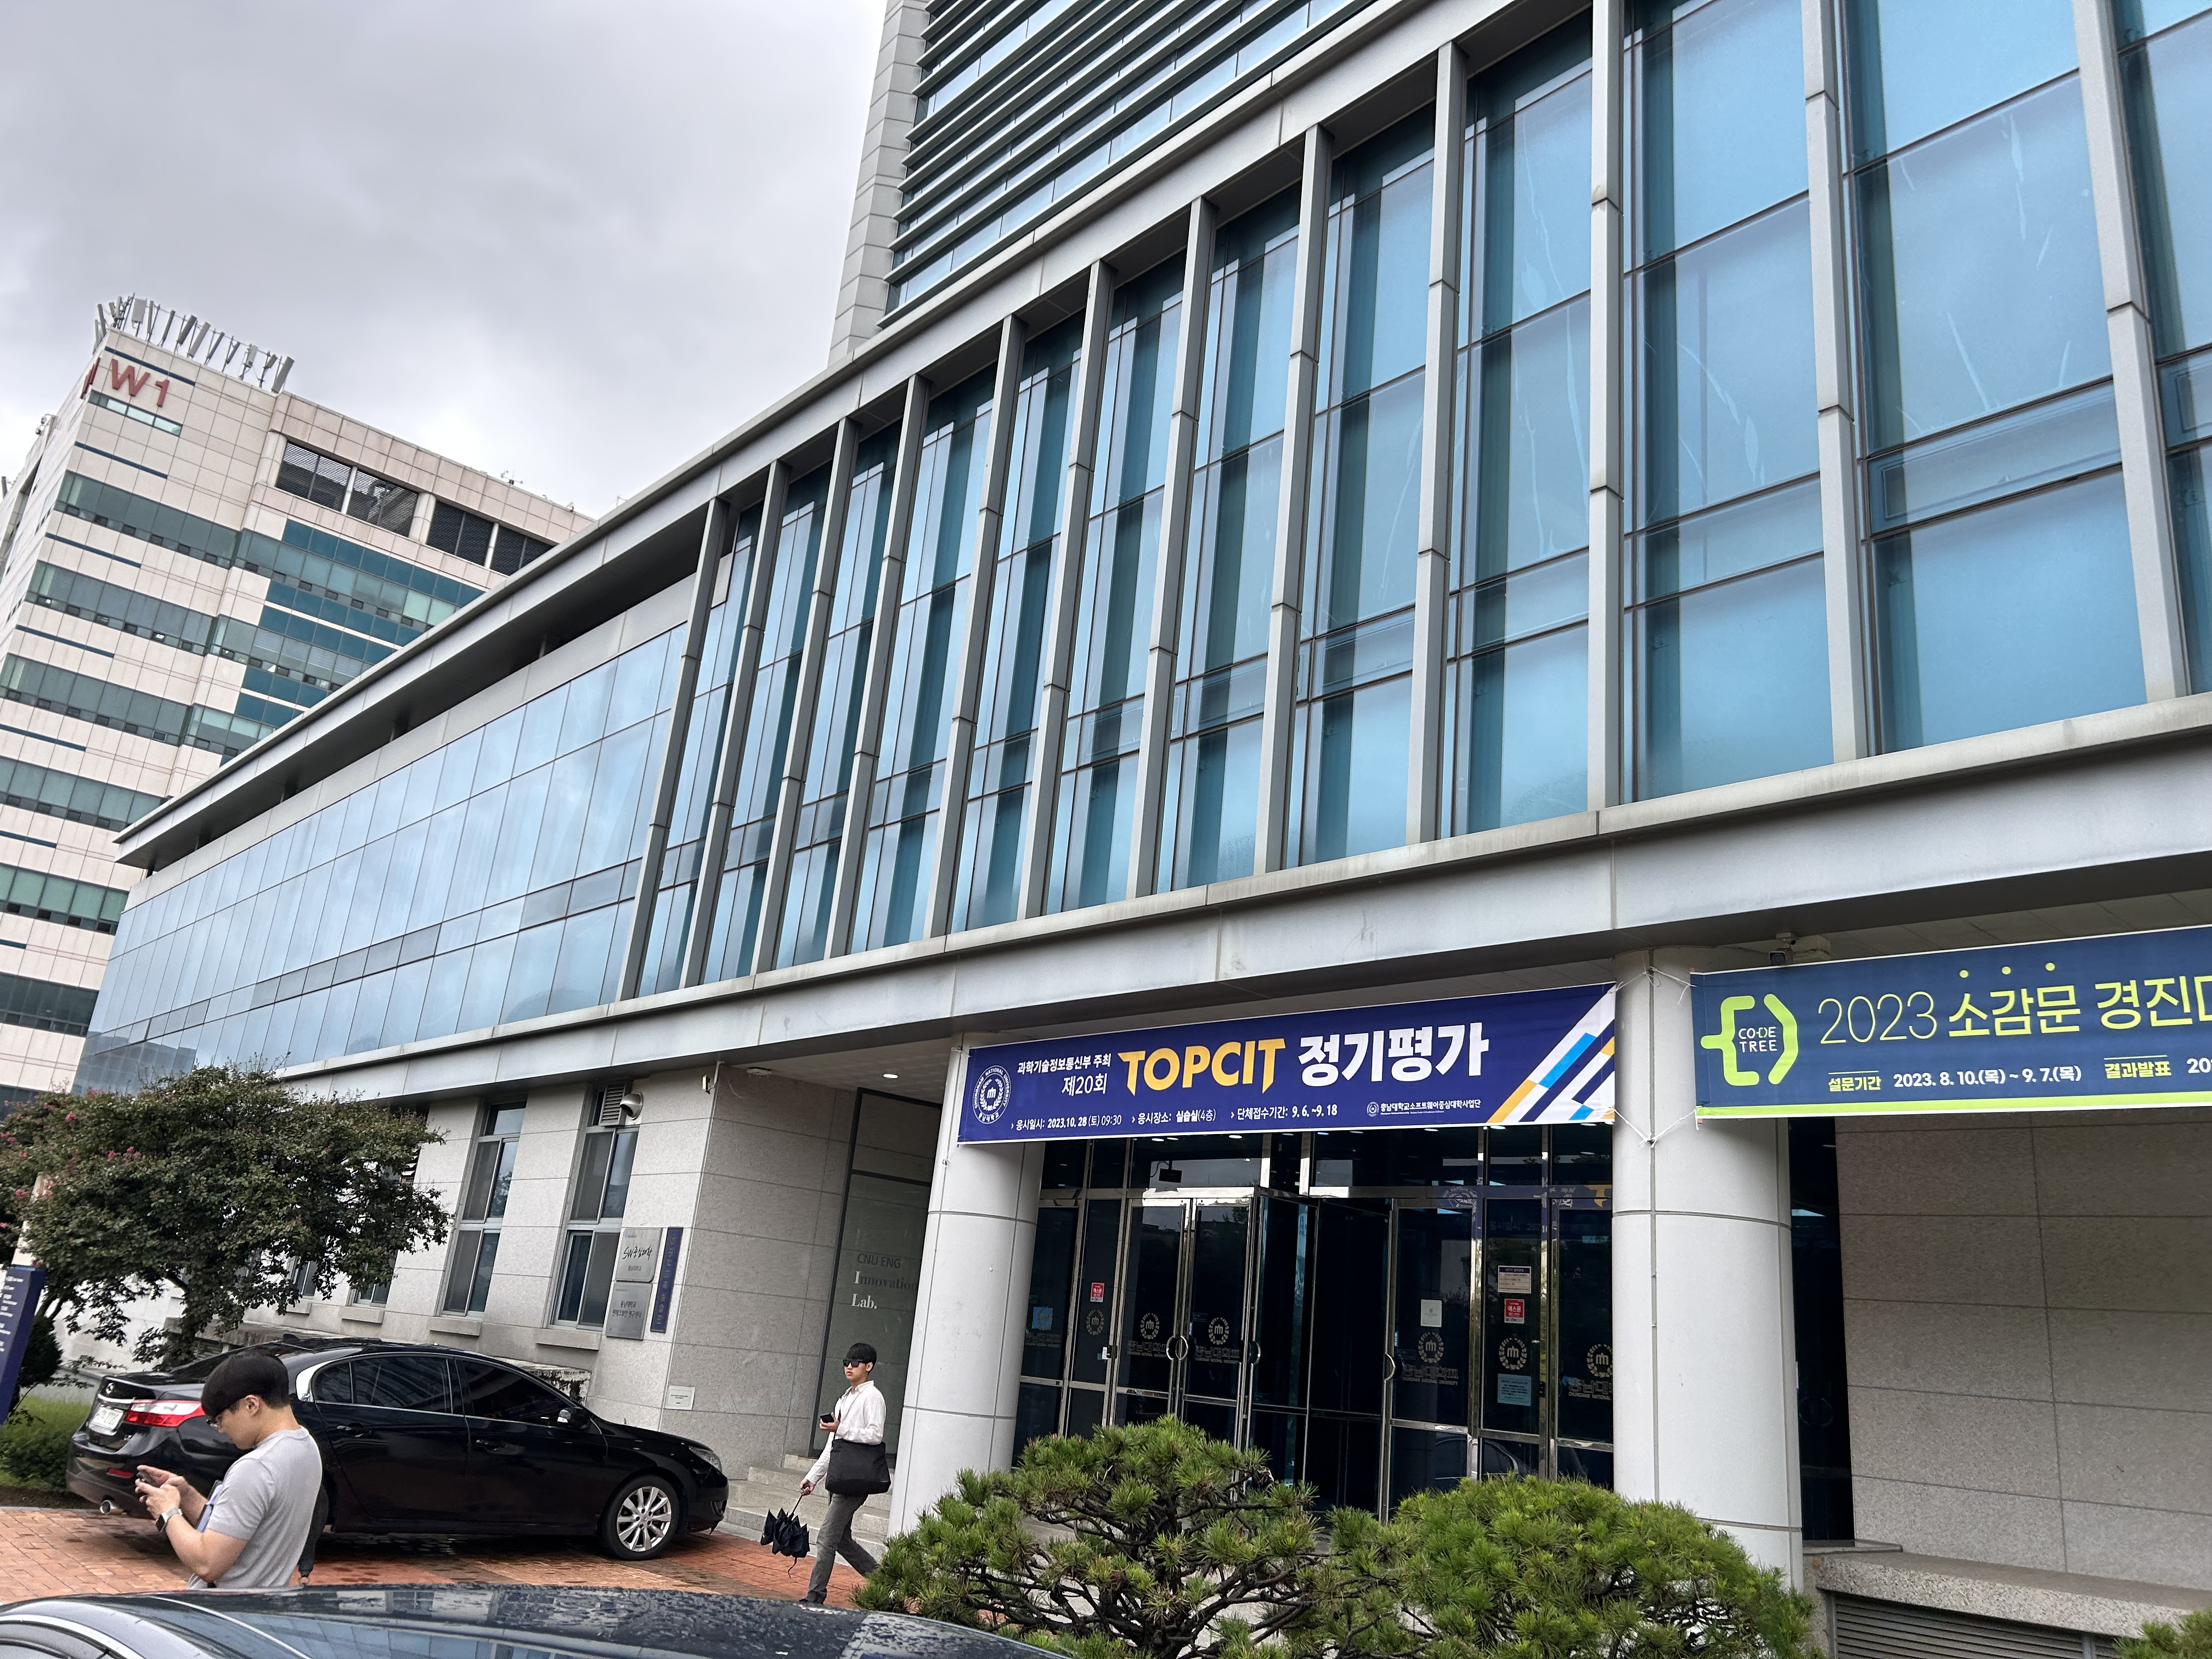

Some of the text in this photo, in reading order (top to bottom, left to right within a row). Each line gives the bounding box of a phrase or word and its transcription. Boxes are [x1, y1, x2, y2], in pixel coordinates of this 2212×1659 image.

[111, 358, 170, 408] W1
[1818, 991, 1938, 1044] 2023
[1948, 985, 2081, 1037] 소감문
[1738, 1026, 1776, 1040] CODE
[1739, 1039, 1778, 1053] TREE
[1017, 1053, 1111, 1075] 과학기술정보통신부 주최
[1061, 1022, 1489, 1096] 제20회 TOPCIT 정기평가
[1828, 1076, 1881, 1092] 설문기간
[1893, 1072, 1936, 1087] 2023.
[1939, 1071, 1954, 1086] 8.
[1957, 1069, 2005, 1085] 10.(목)
[2022, 1068, 2036, 1083] 9.
[2039, 1065, 2081, 1082] 7.(목)
[2104, 1061, 2172, 1079] 결과발표
[2186, 1057, 2212, 1074] 20
[1016, 1118, 1045, 1131] 응시일시:
[1101, 1114, 1122, 1126] 09:30
[1137, 1111, 1172, 1125] 응시장소:
[1176, 1108, 1217, 1123] 실습실(4층)
[1237, 1106, 1288, 1121] 단체접수기간:
[622, 1244, 653, 1261] SW중심대학
[857, 1253, 901, 1268] CNU ENG
[851, 1293, 877, 1309] Lab.
[1568, 1376, 1612, 1395] 충남대
